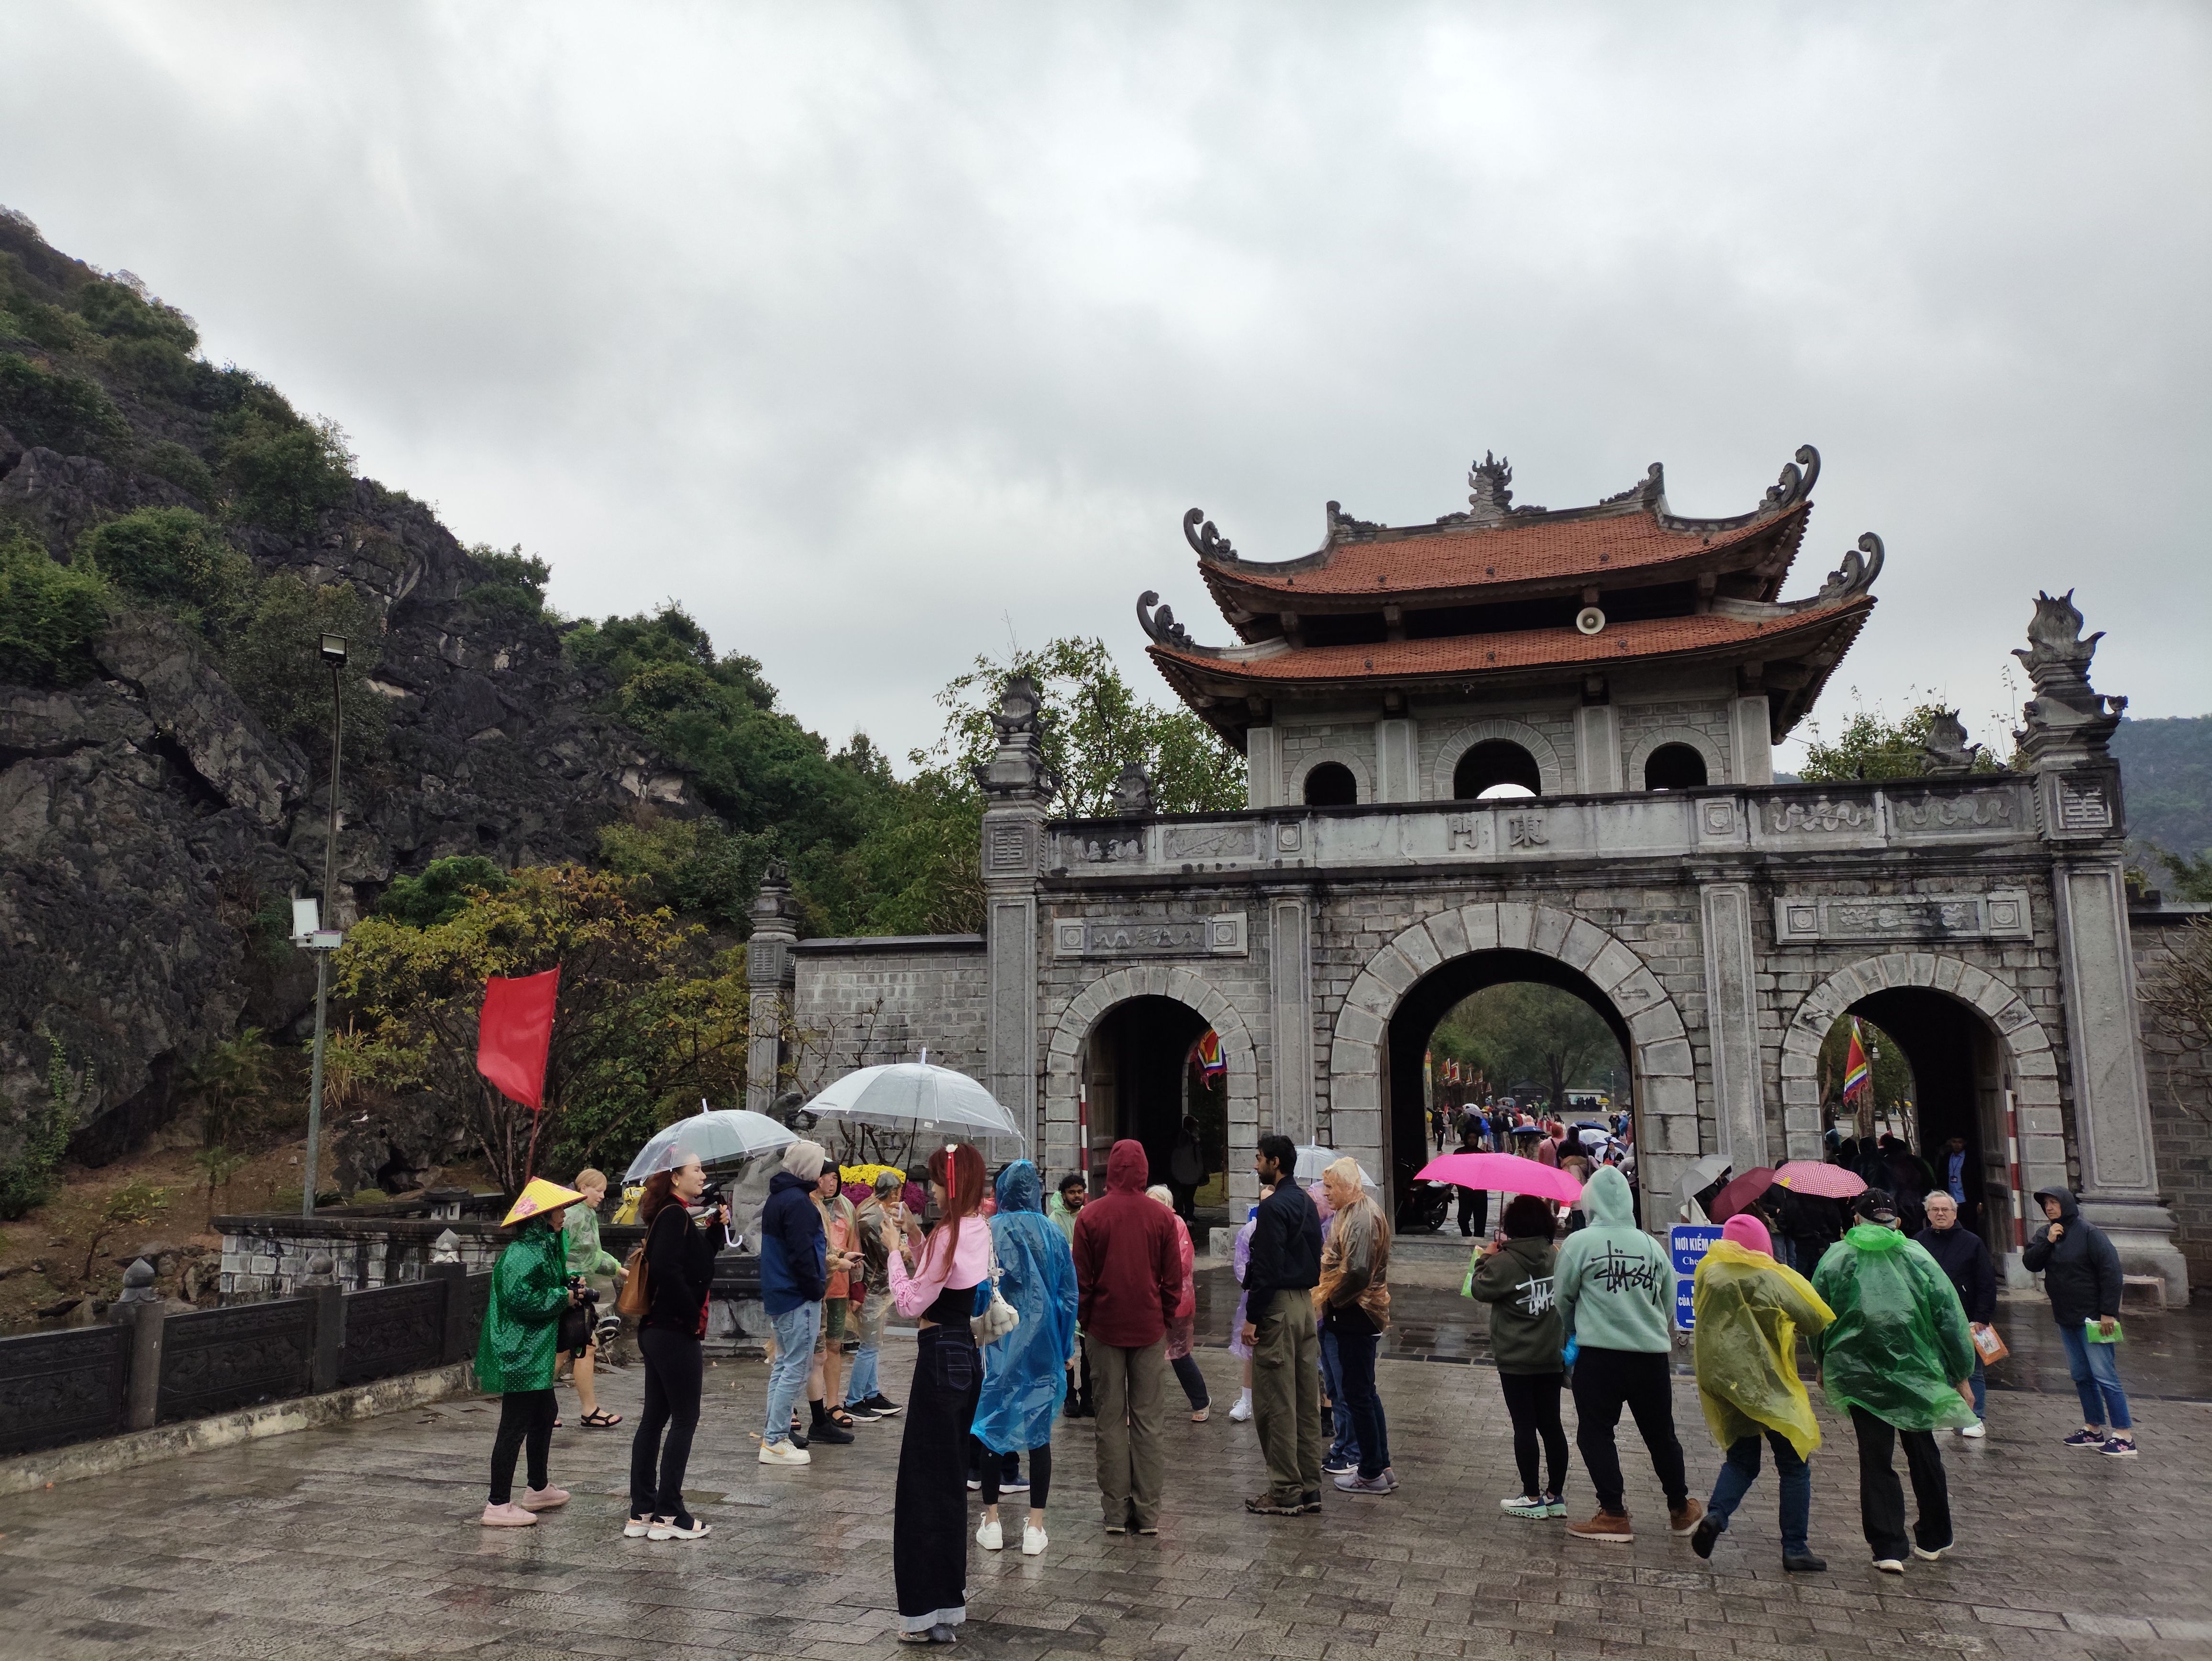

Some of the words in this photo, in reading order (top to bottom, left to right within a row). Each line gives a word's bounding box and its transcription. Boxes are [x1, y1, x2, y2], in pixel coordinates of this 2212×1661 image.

[1675, 1237, 1688, 1251] NƠI
[1689, 1233, 1709, 1251] KIỂM
[1678, 1294, 1691, 1307] CỦA
